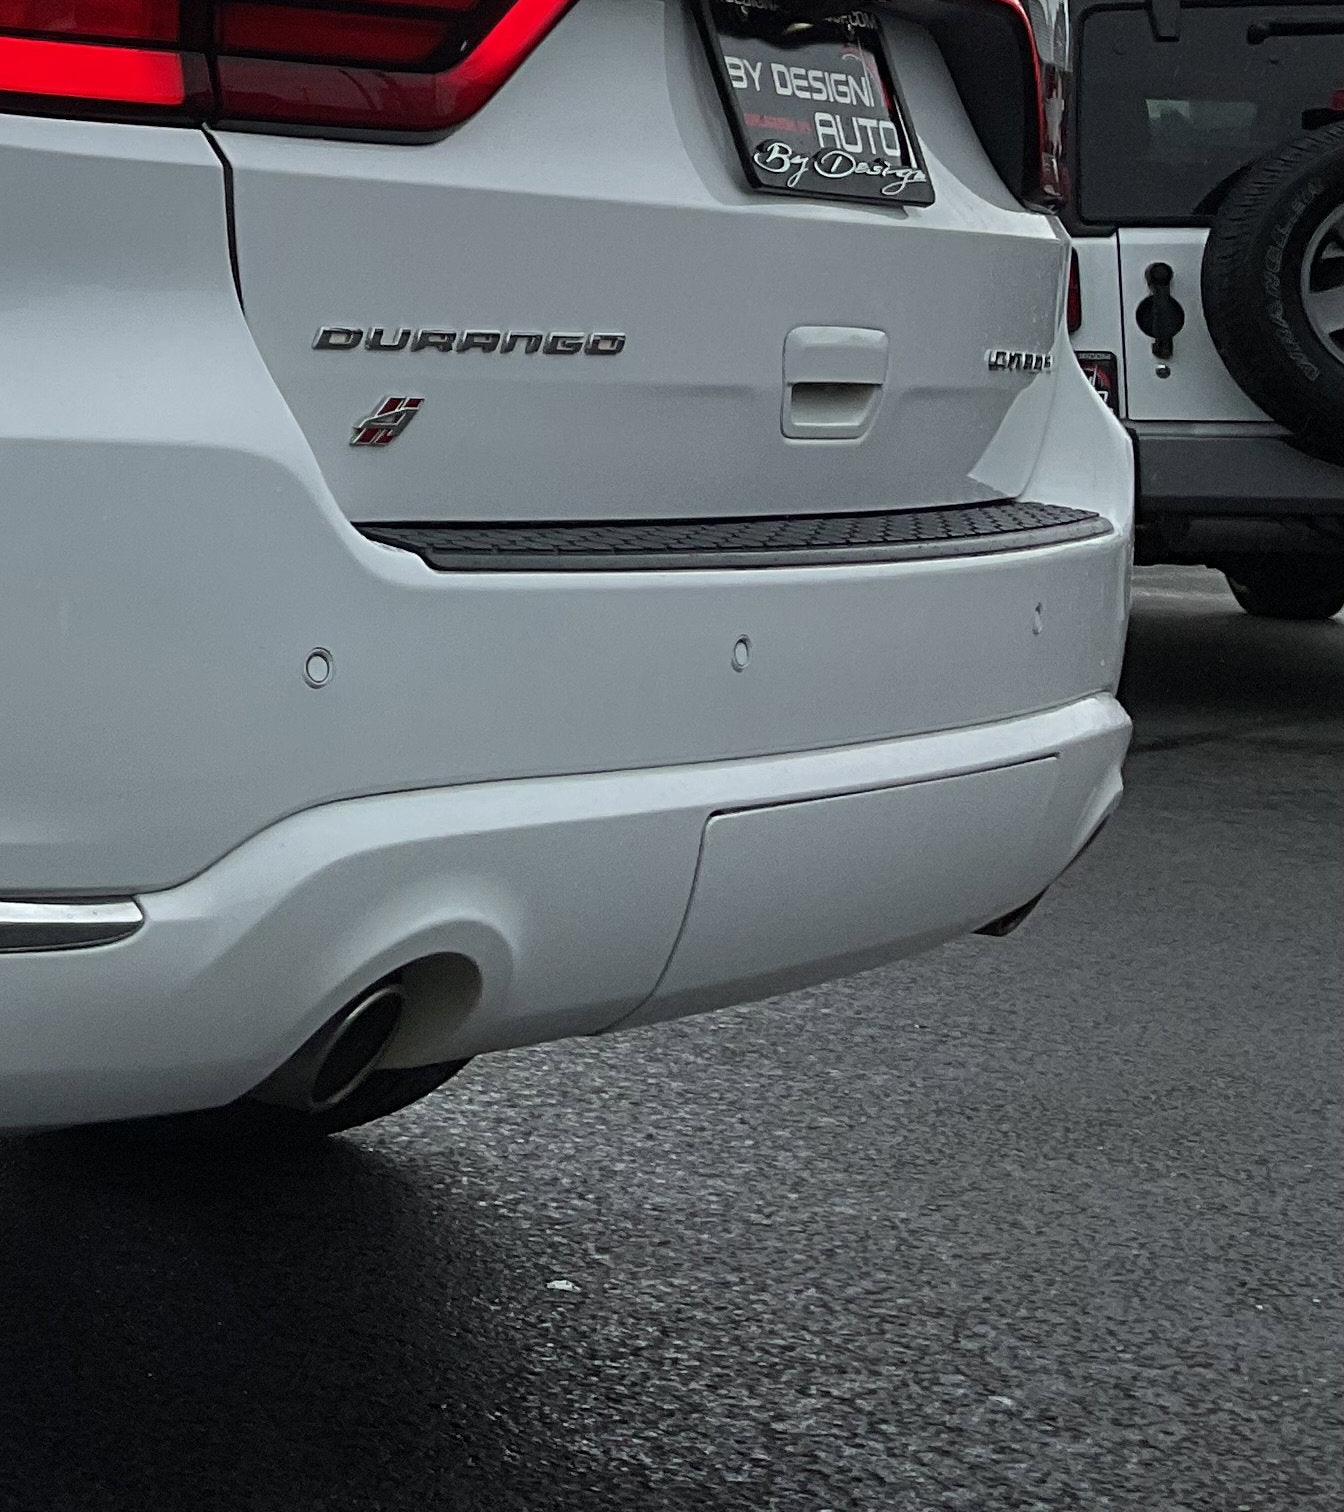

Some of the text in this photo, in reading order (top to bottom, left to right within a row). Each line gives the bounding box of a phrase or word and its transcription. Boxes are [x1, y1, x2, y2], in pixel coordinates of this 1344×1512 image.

[723, 54, 875, 108] BY DESIGN
[814, 111, 901, 157] AUTO
[753, 141, 809, 188] By
[312, 326, 627, 356] DURANGO
